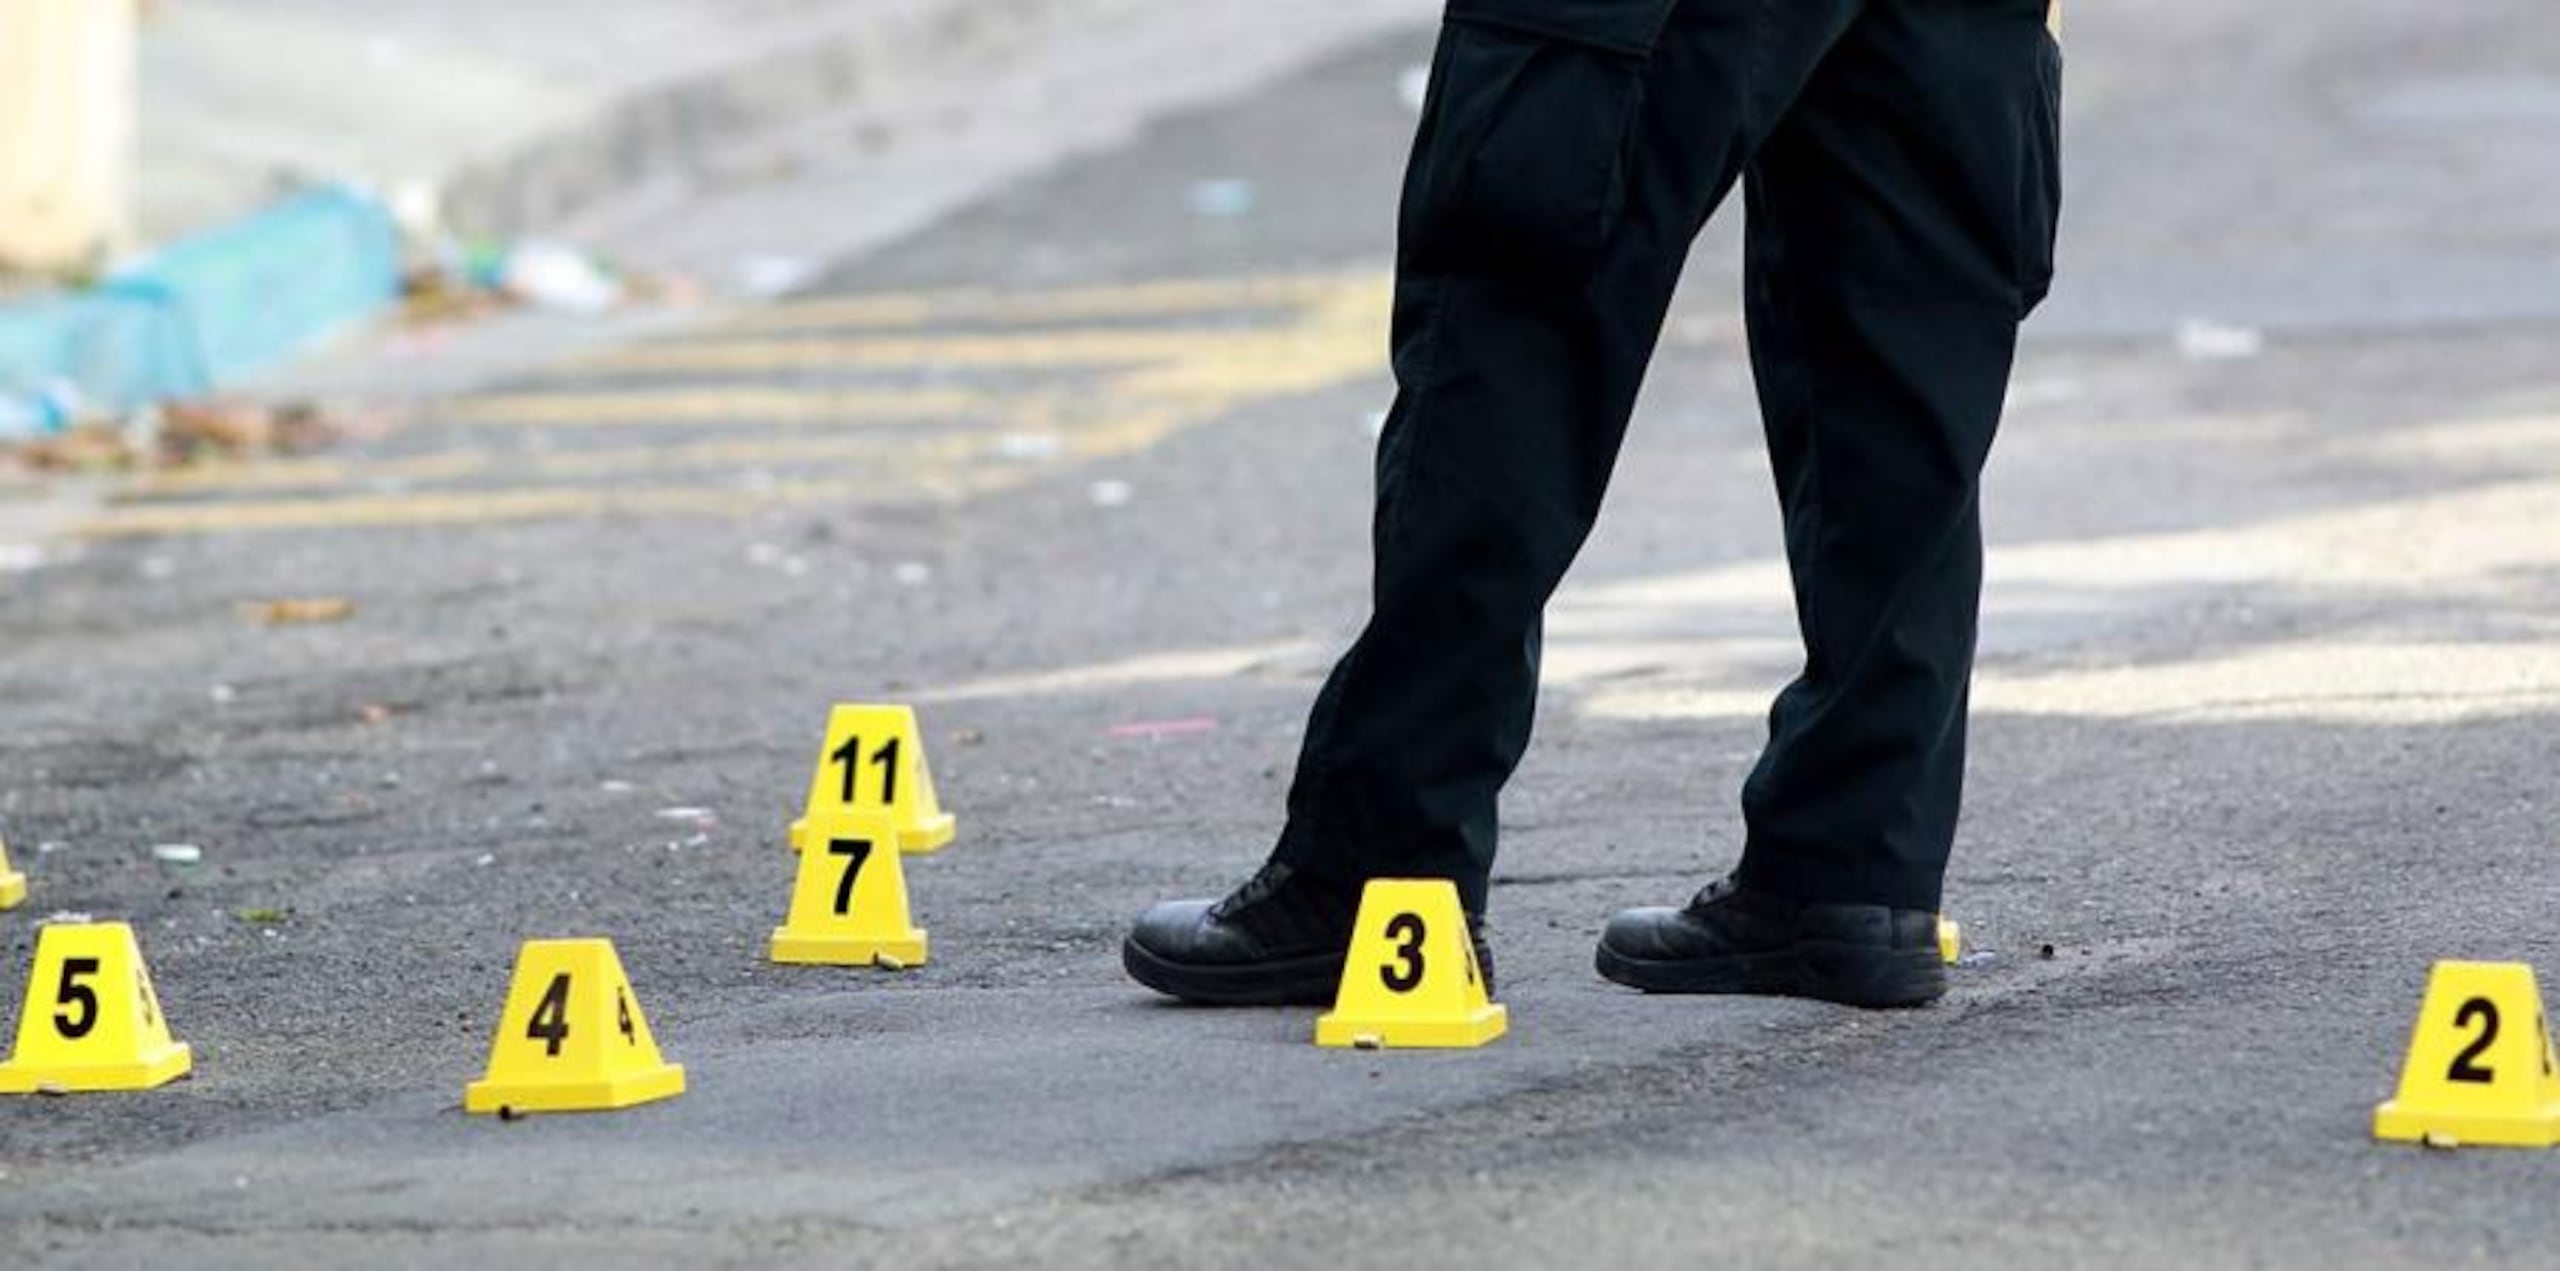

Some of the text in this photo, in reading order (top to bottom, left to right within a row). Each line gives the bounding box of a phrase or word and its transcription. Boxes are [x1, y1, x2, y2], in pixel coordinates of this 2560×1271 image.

[831, 737, 900, 804] 11
[828, 839, 872, 915] 7
[1380, 912, 1426, 993] 3
[54, 958, 99, 1038] 5
[527, 974, 569, 1055] 4
[618, 986, 635, 1045] 4
[2447, 997, 2499, 1083] 2
